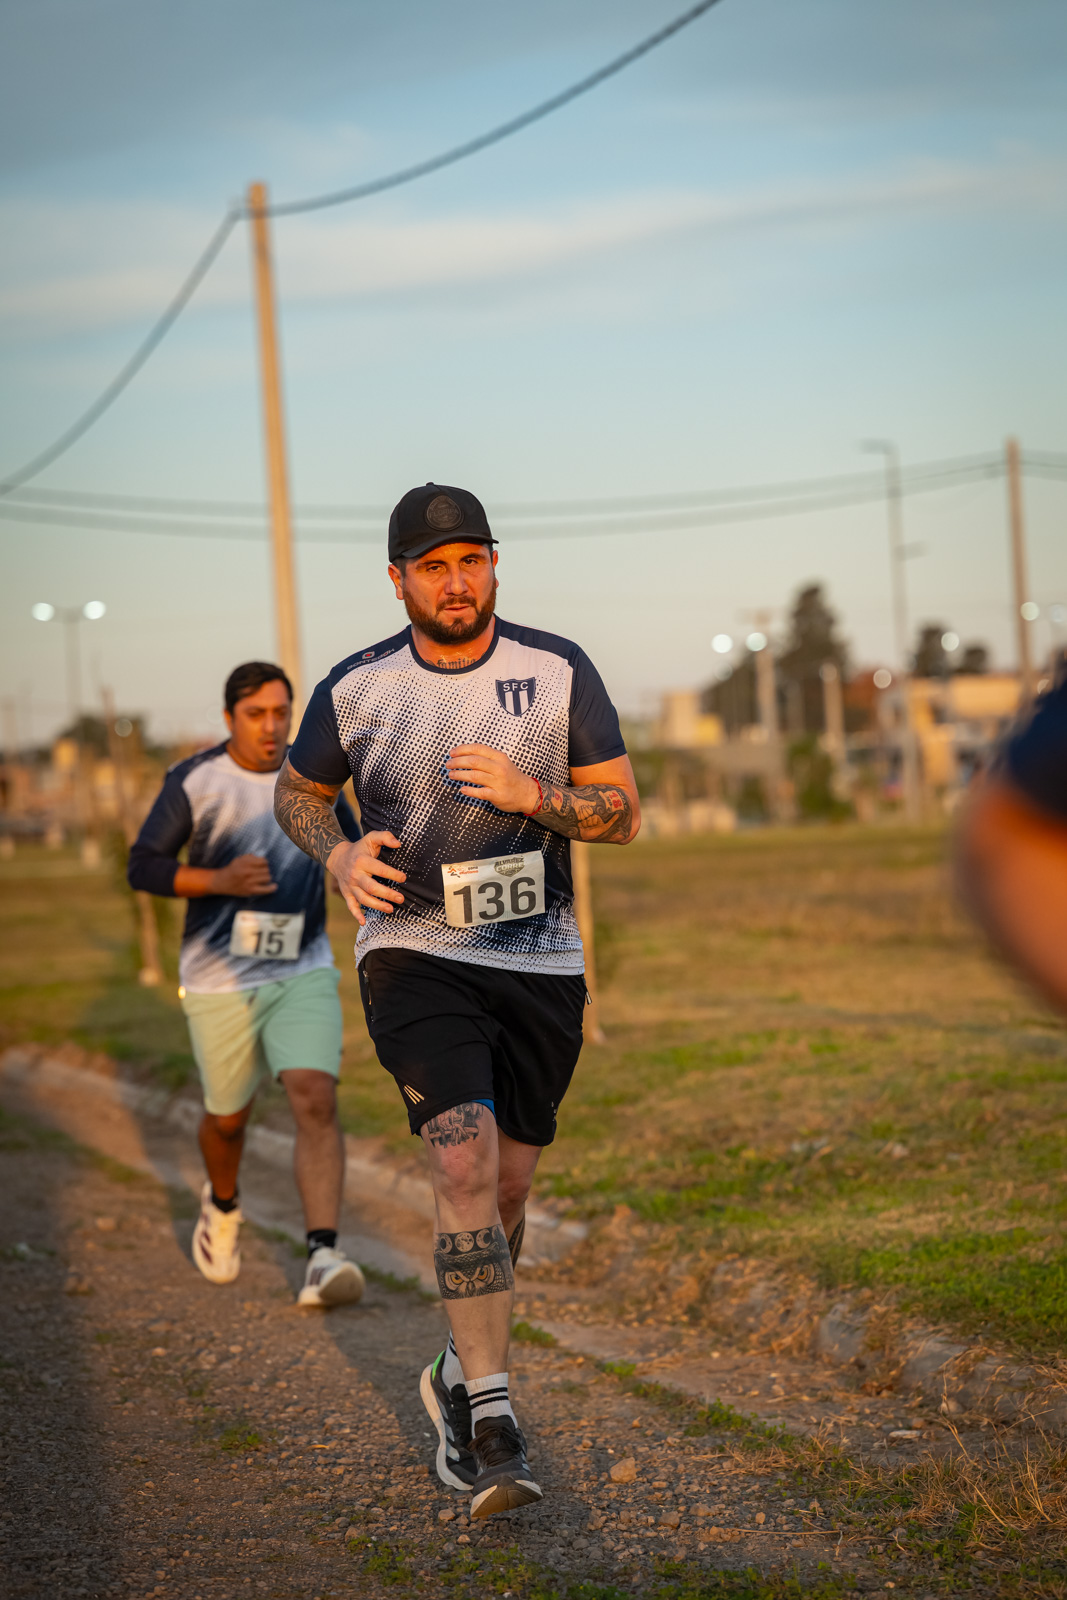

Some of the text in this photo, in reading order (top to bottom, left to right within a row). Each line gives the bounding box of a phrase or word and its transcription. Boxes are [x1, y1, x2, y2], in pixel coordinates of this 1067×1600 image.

[503, 682, 529, 692] SFC
[496, 862, 525, 872] CORRE
[453, 877, 536, 924] 136
[250, 931, 284, 956] 15
